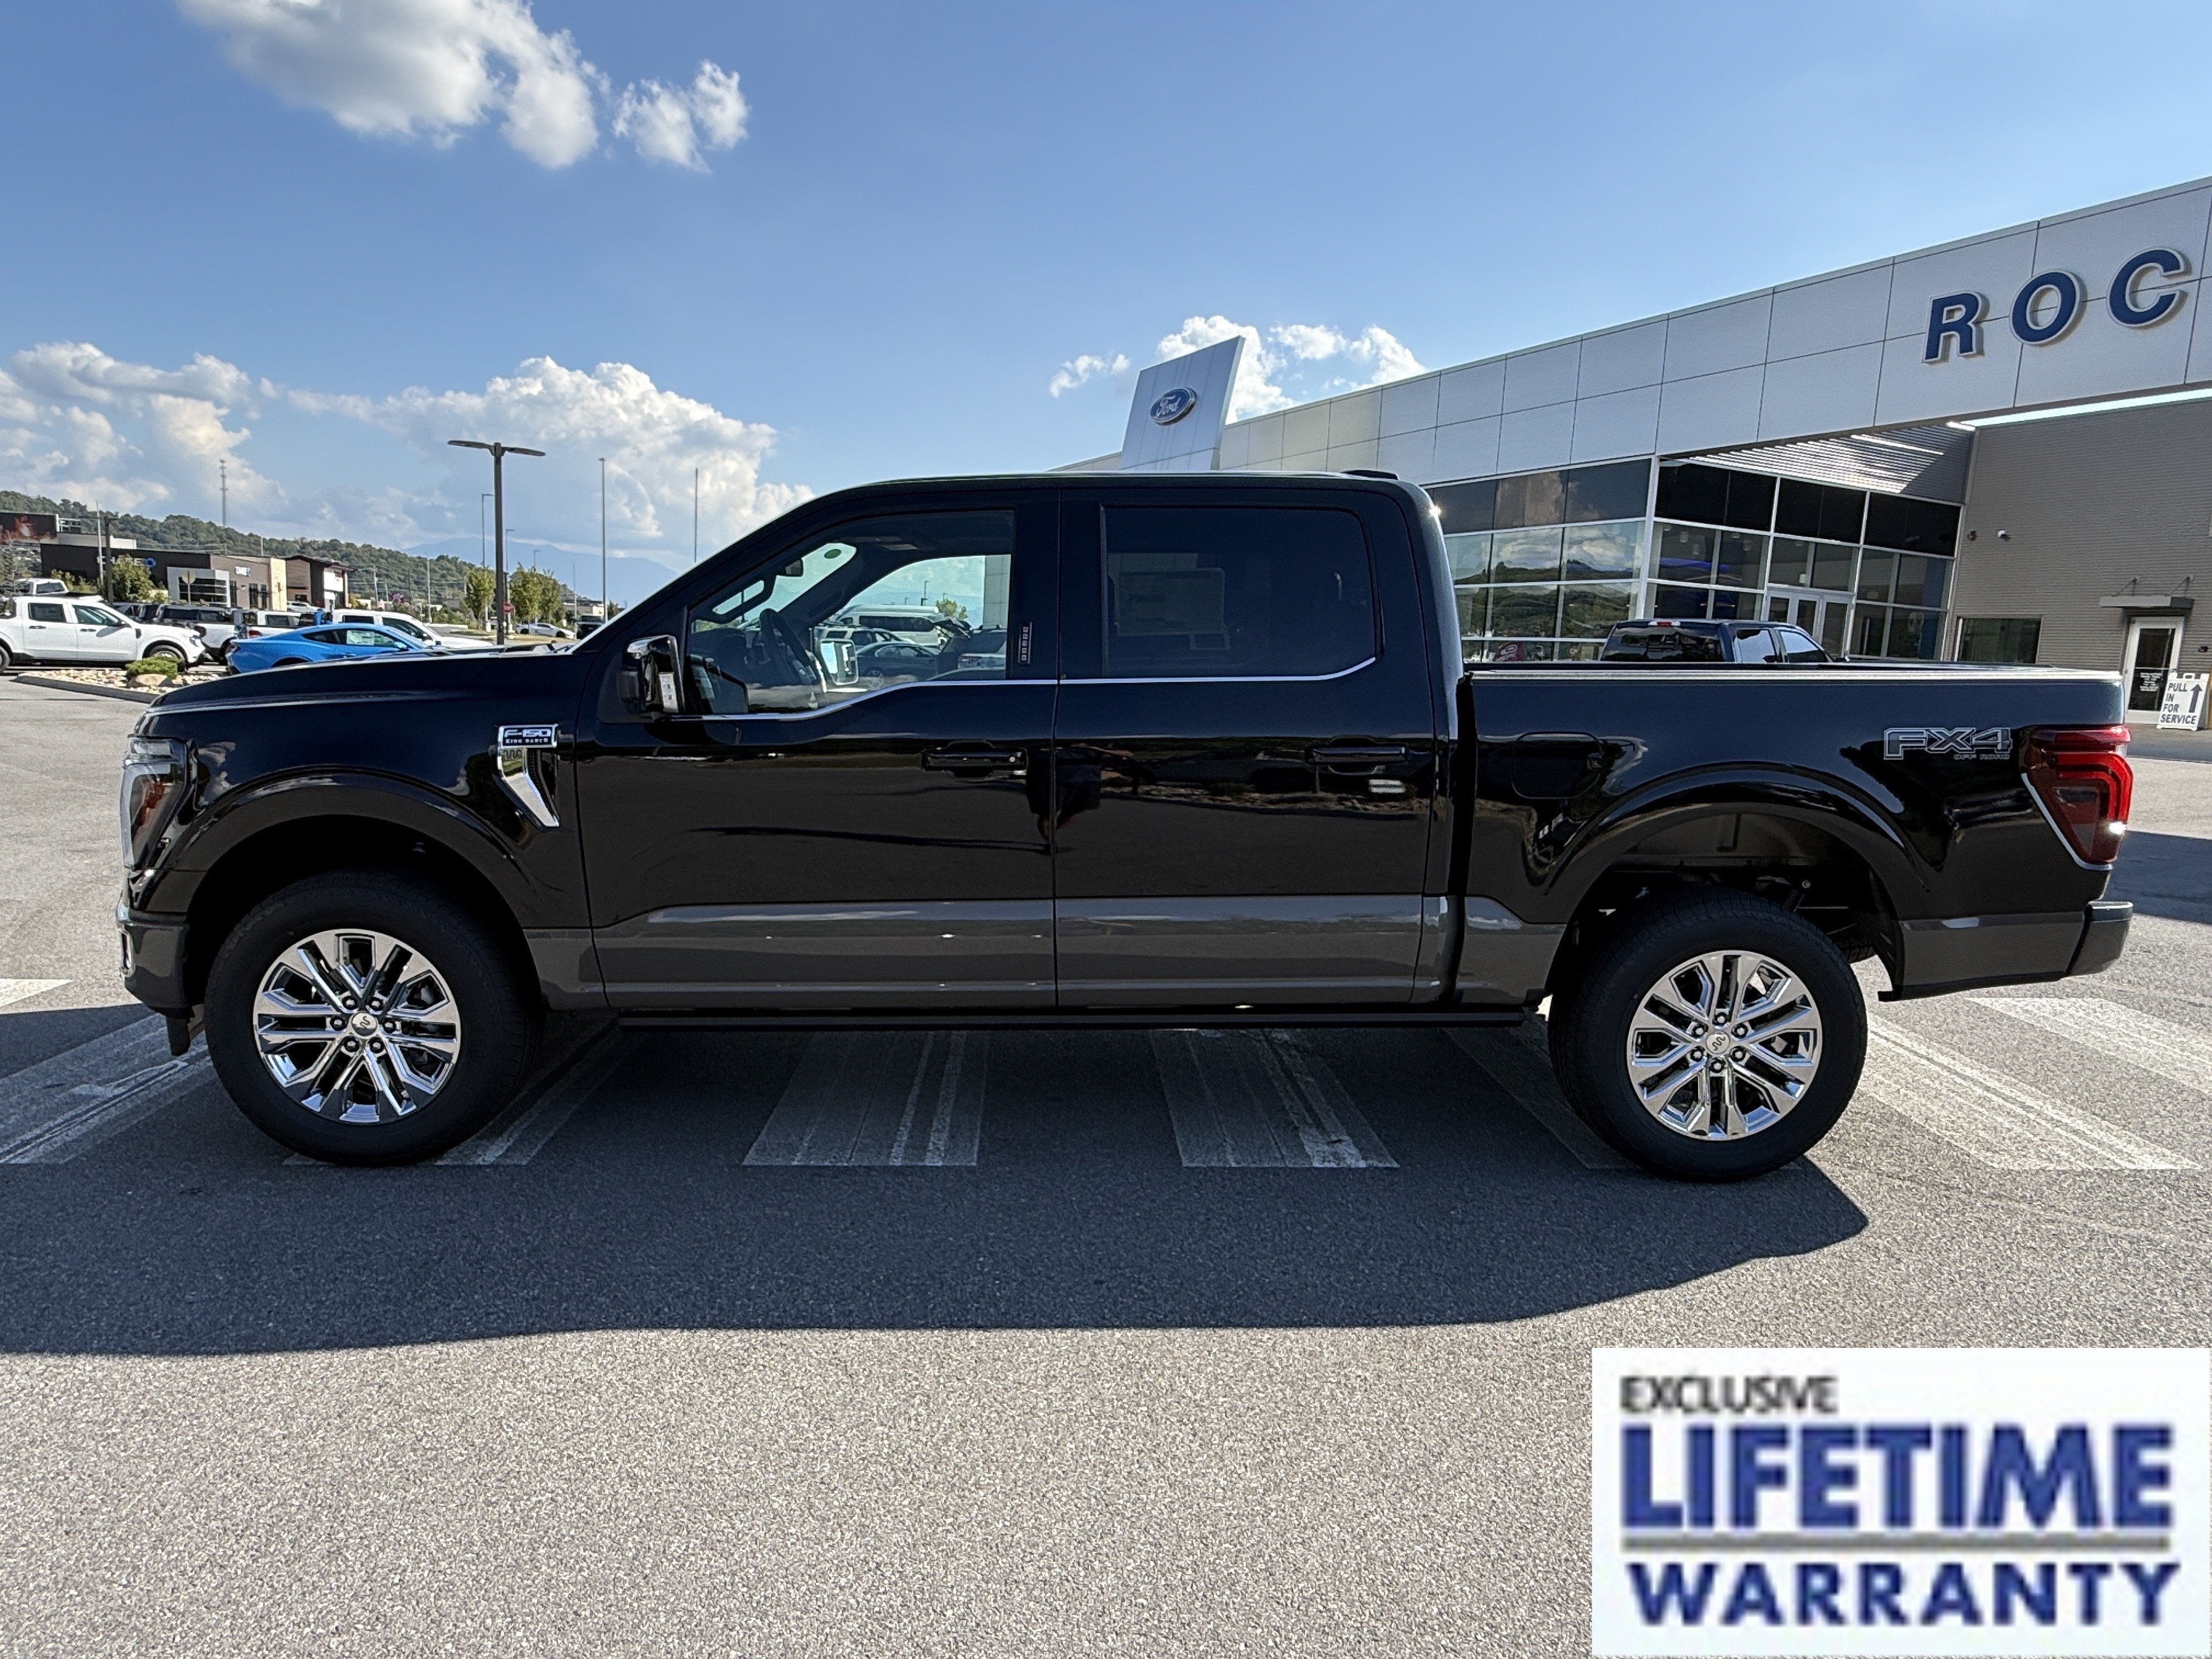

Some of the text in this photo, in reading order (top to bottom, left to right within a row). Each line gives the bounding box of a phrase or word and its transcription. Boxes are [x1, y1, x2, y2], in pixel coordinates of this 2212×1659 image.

[1922, 246, 2190, 363] ROC
[1156, 395, 1181, 417] Ford
[97, 556, 143, 566] CHE
[2168, 682, 2188, 692] PULL
[2165, 693, 2175, 702] IN
[2163, 703, 2180, 713] FOR
[2160, 714, 2198, 724] SERVICE
[504, 729, 551, 738] F-150
[1883, 727, 2013, 760] FX4
